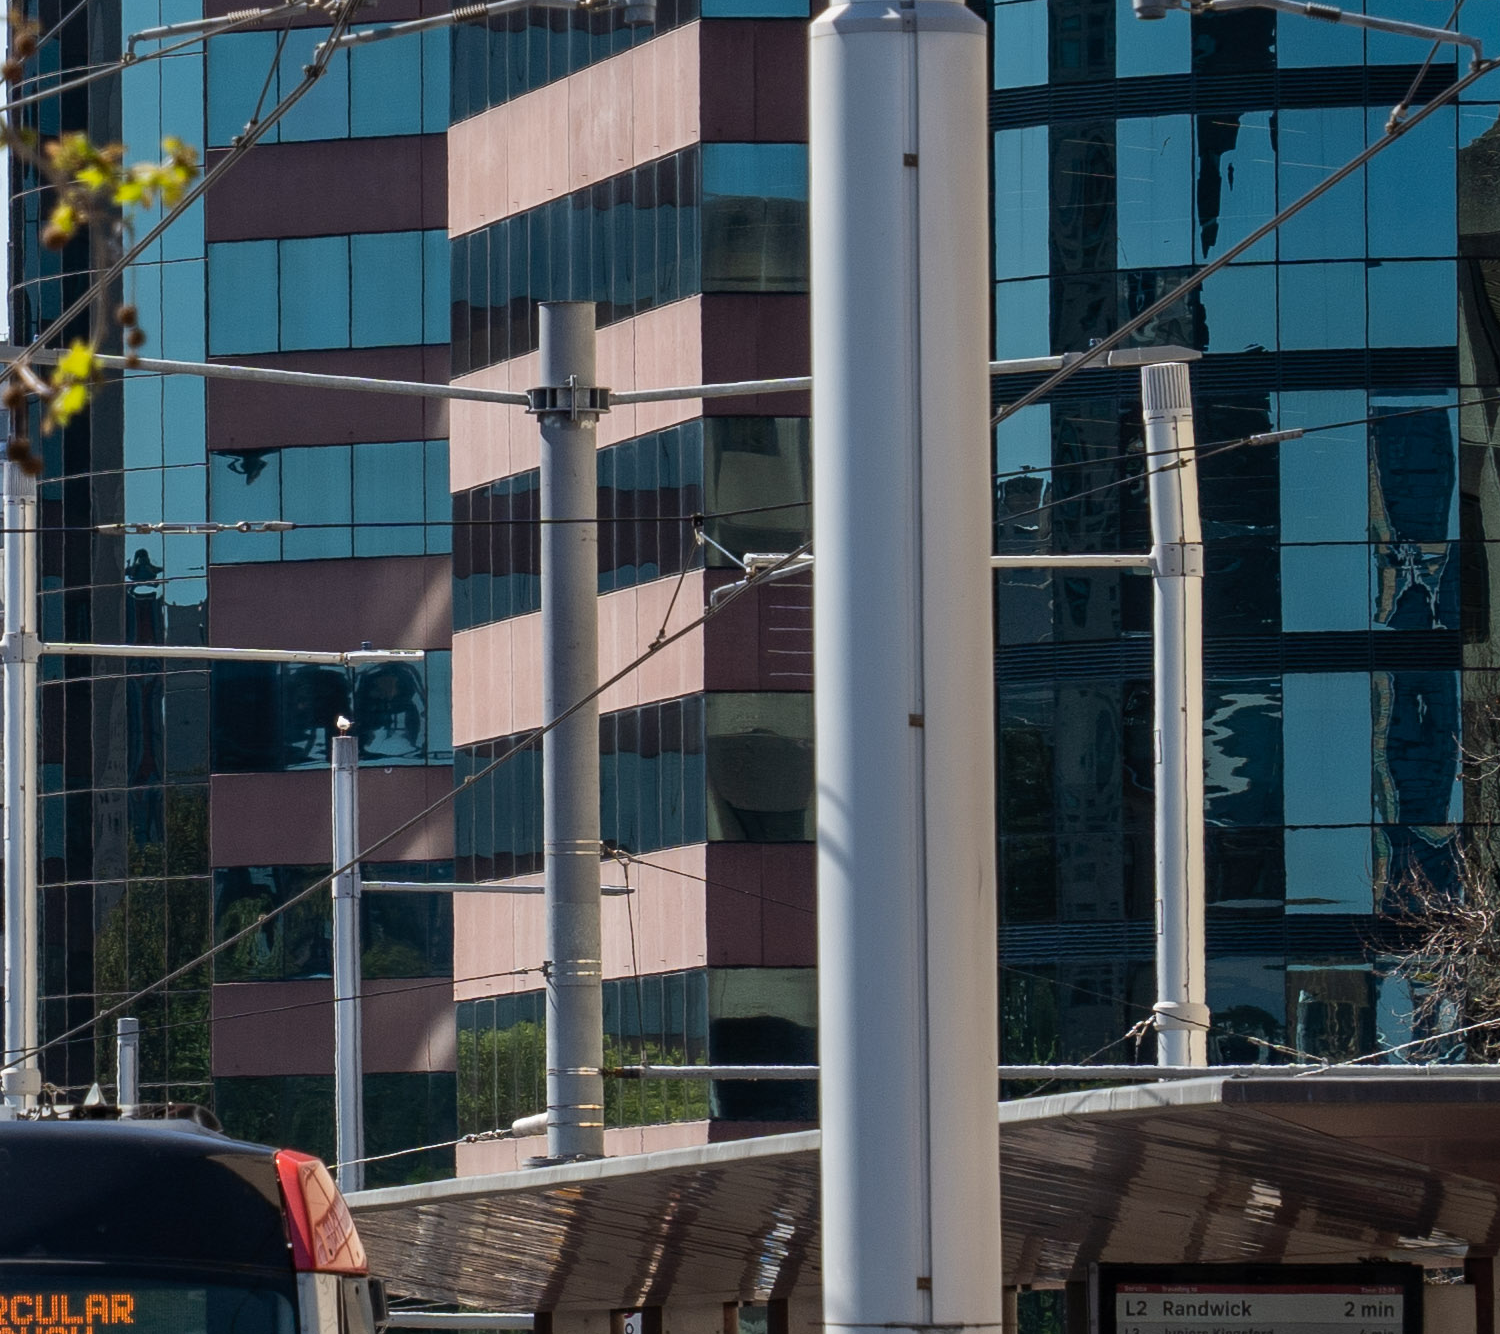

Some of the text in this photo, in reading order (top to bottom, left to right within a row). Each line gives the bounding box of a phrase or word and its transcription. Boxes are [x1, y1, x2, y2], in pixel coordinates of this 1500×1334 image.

[1125, 1300, 1394, 1317] L2 Randwick 2 min
[625, 1323, 634, 1334] O
